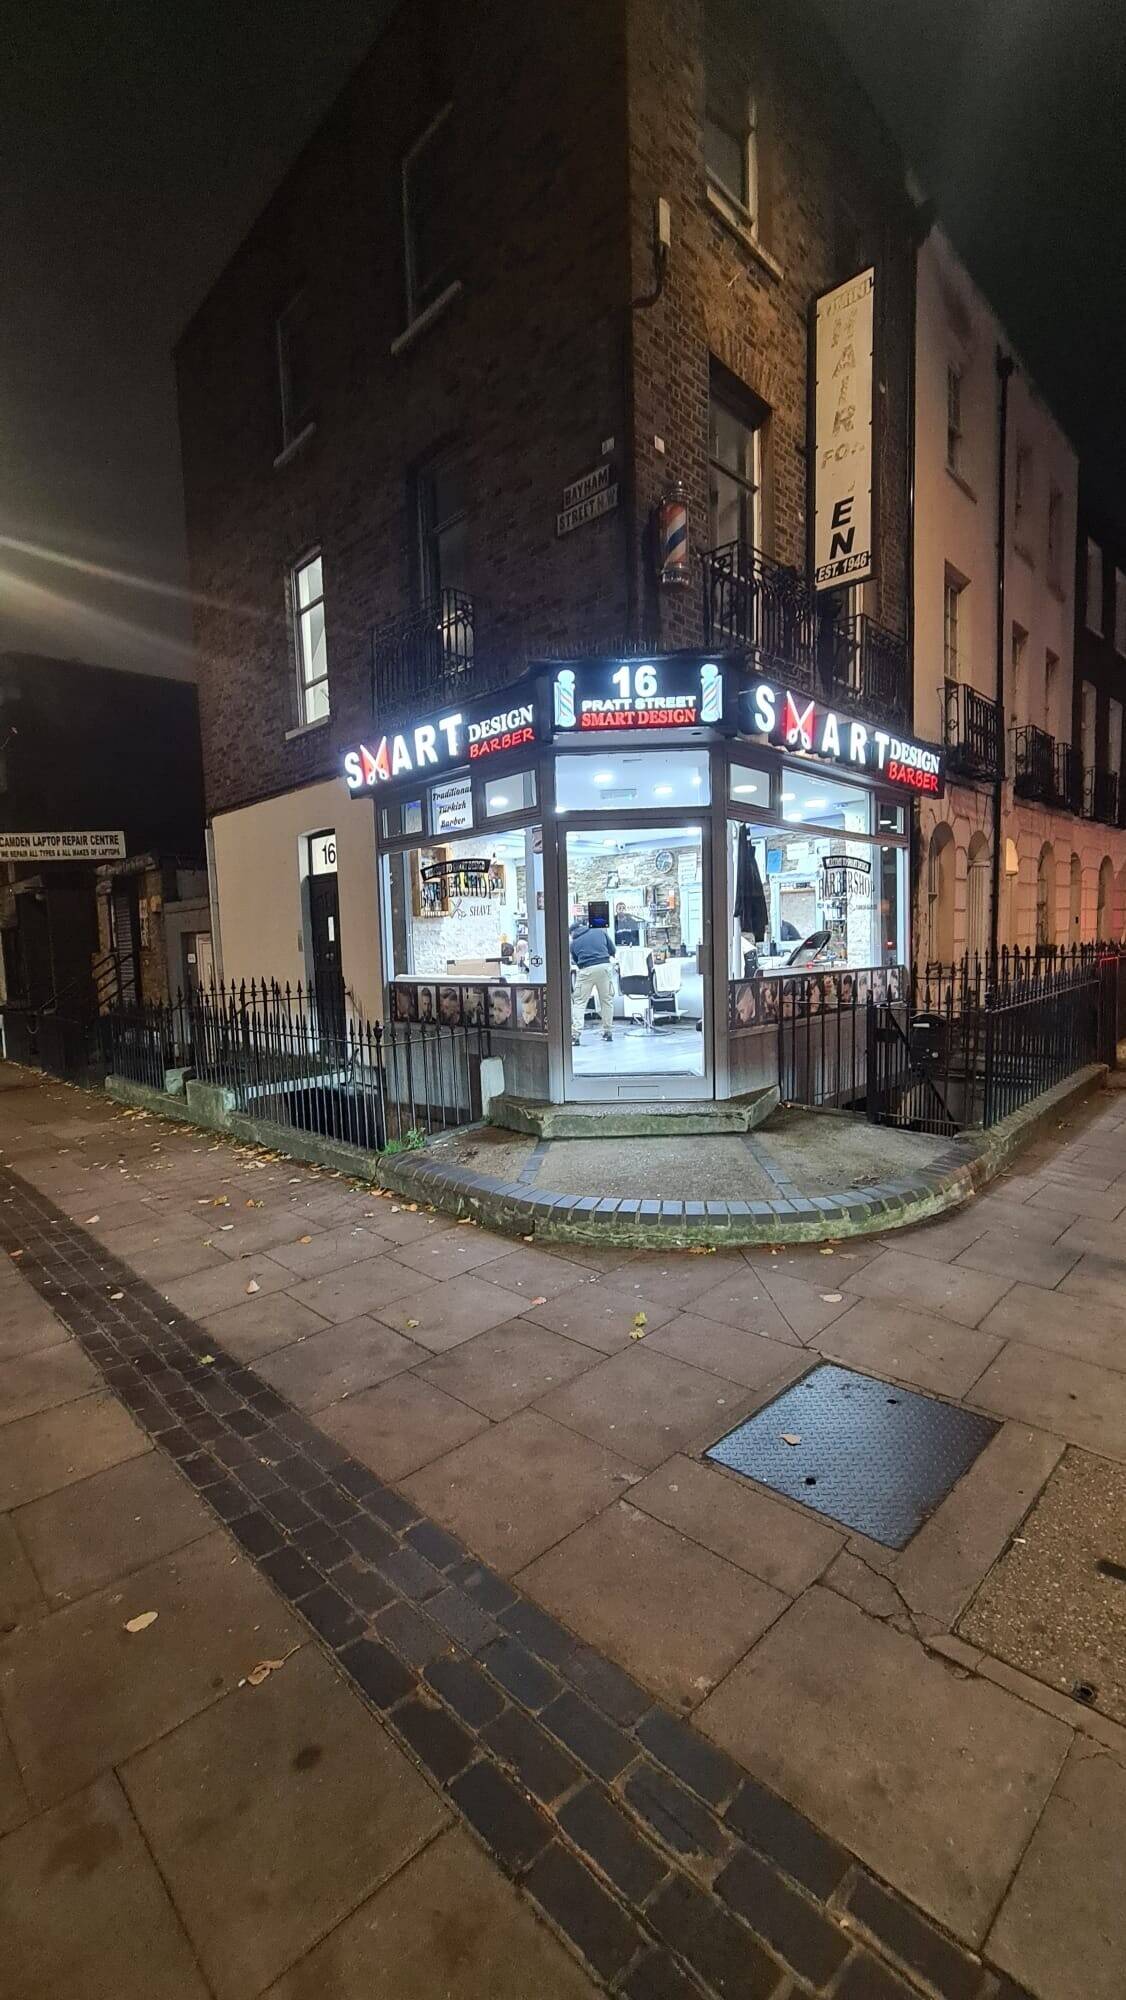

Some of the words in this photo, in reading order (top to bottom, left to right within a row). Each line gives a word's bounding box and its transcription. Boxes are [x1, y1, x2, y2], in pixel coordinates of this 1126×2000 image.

[565, 470, 608, 505] BAYHAM
[559, 499, 595, 530] STREET
[818, 563, 839, 581] EST.
[842, 553, 868, 573] 1946
[612, 665, 658, 698] 16
[581, 698, 632, 712] PRATT
[634, 696, 697, 709] STREET
[581, 711, 636, 727] SMART
[637, 708, 697, 725] DESIGN
[468, 704, 534, 742] DESIGN
[469, 727, 535, 758] BARBER
[889, 738, 941, 775] DESIGN
[888, 761, 939, 792] BARBER
[439, 800, 466, 814] Turkish
[440, 816, 466, 828] Barber
[0, 836, 30, 847] CAMDEN
[33, 835, 60, 846] LAPTOP
[62, 835, 88, 846] REPAIR
[90, 834, 119, 845] CENTRE
[40, 849, 55, 857] TYPES
[322, 843, 336, 864] 16
